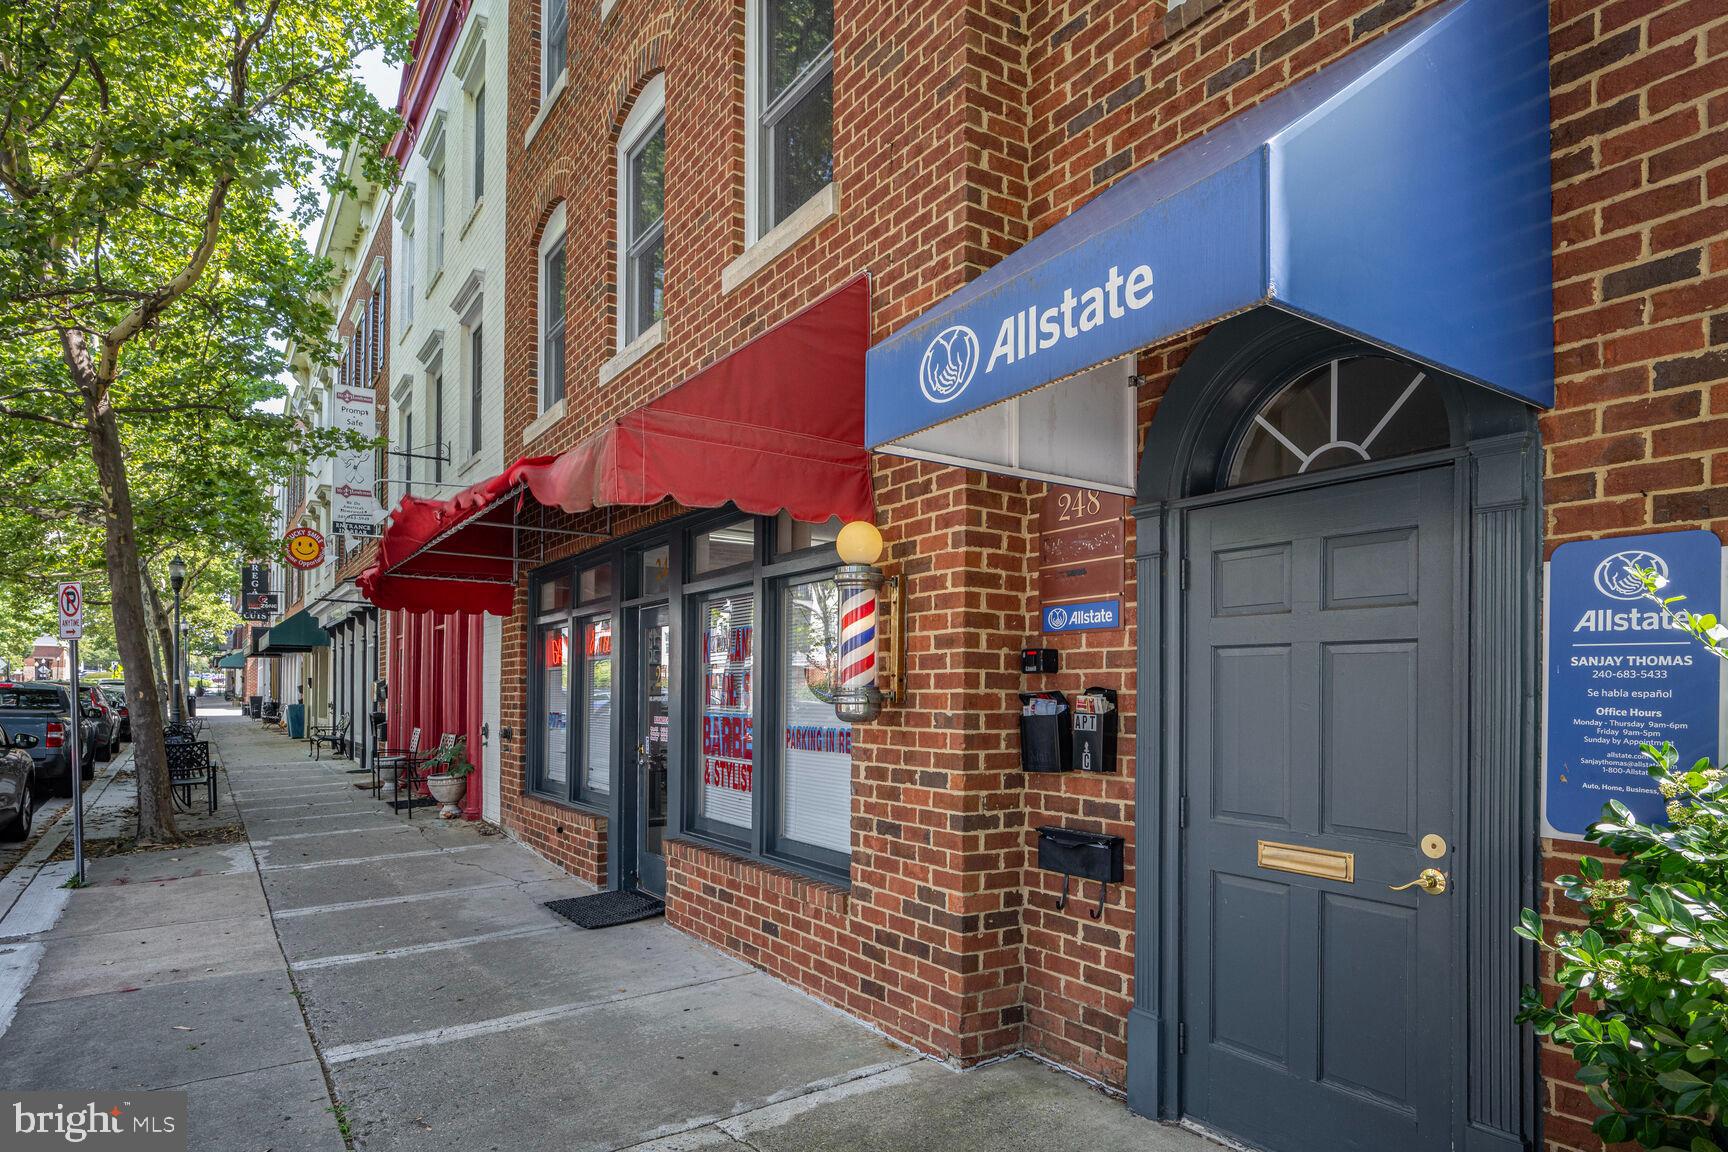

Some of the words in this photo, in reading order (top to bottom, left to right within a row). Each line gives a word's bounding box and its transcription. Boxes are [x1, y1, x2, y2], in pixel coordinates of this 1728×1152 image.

[985, 264, 1154, 374] Allstate
[341, 405, 369, 416] Prompt
[346, 418, 364, 427] Safe
[1058, 489, 1101, 522] 248
[287, 529, 306, 539] UCKY
[62, 618, 80, 627] ANYTIME
[1068, 608, 1113, 626] Allstate
[1572, 608, 1690, 633] Allstate
[1570, 656, 1624, 667] SANJAY
[1626, 655, 1693, 667] THOMAS
[1592, 669, 1668, 679] 240-683-5433
[1587, 688, 1599, 697] Se
[1601, 689, 1629, 698] habla
[1631, 689, 1673, 700] español
[1596, 707, 1628, 717] Office
[1630, 708, 1662, 718] Hours
[1075, 715, 1096, 729] APT
[1573, 718, 1603, 728] Monday
[1609, 719, 1645, 729] Thursday
[1648, 721, 1688, 730] 9am-6pm
[703, 713, 753, 760] BARBE
[1596, 728, 1620, 737] Friday
[1622, 729, 1661, 738] 9am-5pm
[785, 726, 823, 752] PARKING
[825, 728, 836, 753] IN
[1583, 735, 1611, 745] Sunday
[1612, 736, 1622, 746] by
[1623, 738, 1675, 747] Appointmt
[1084, 753, 1090, 768] C
[704, 759, 711, 785] &
[714, 759, 753, 793] STYLIST
[1602, 766, 1649, 776] 1-800-Allstat
[1582, 782, 1601, 791] Auto,
[1602, 784, 1625, 793] Home,
[1626, 786, 1660, 795] Business,
